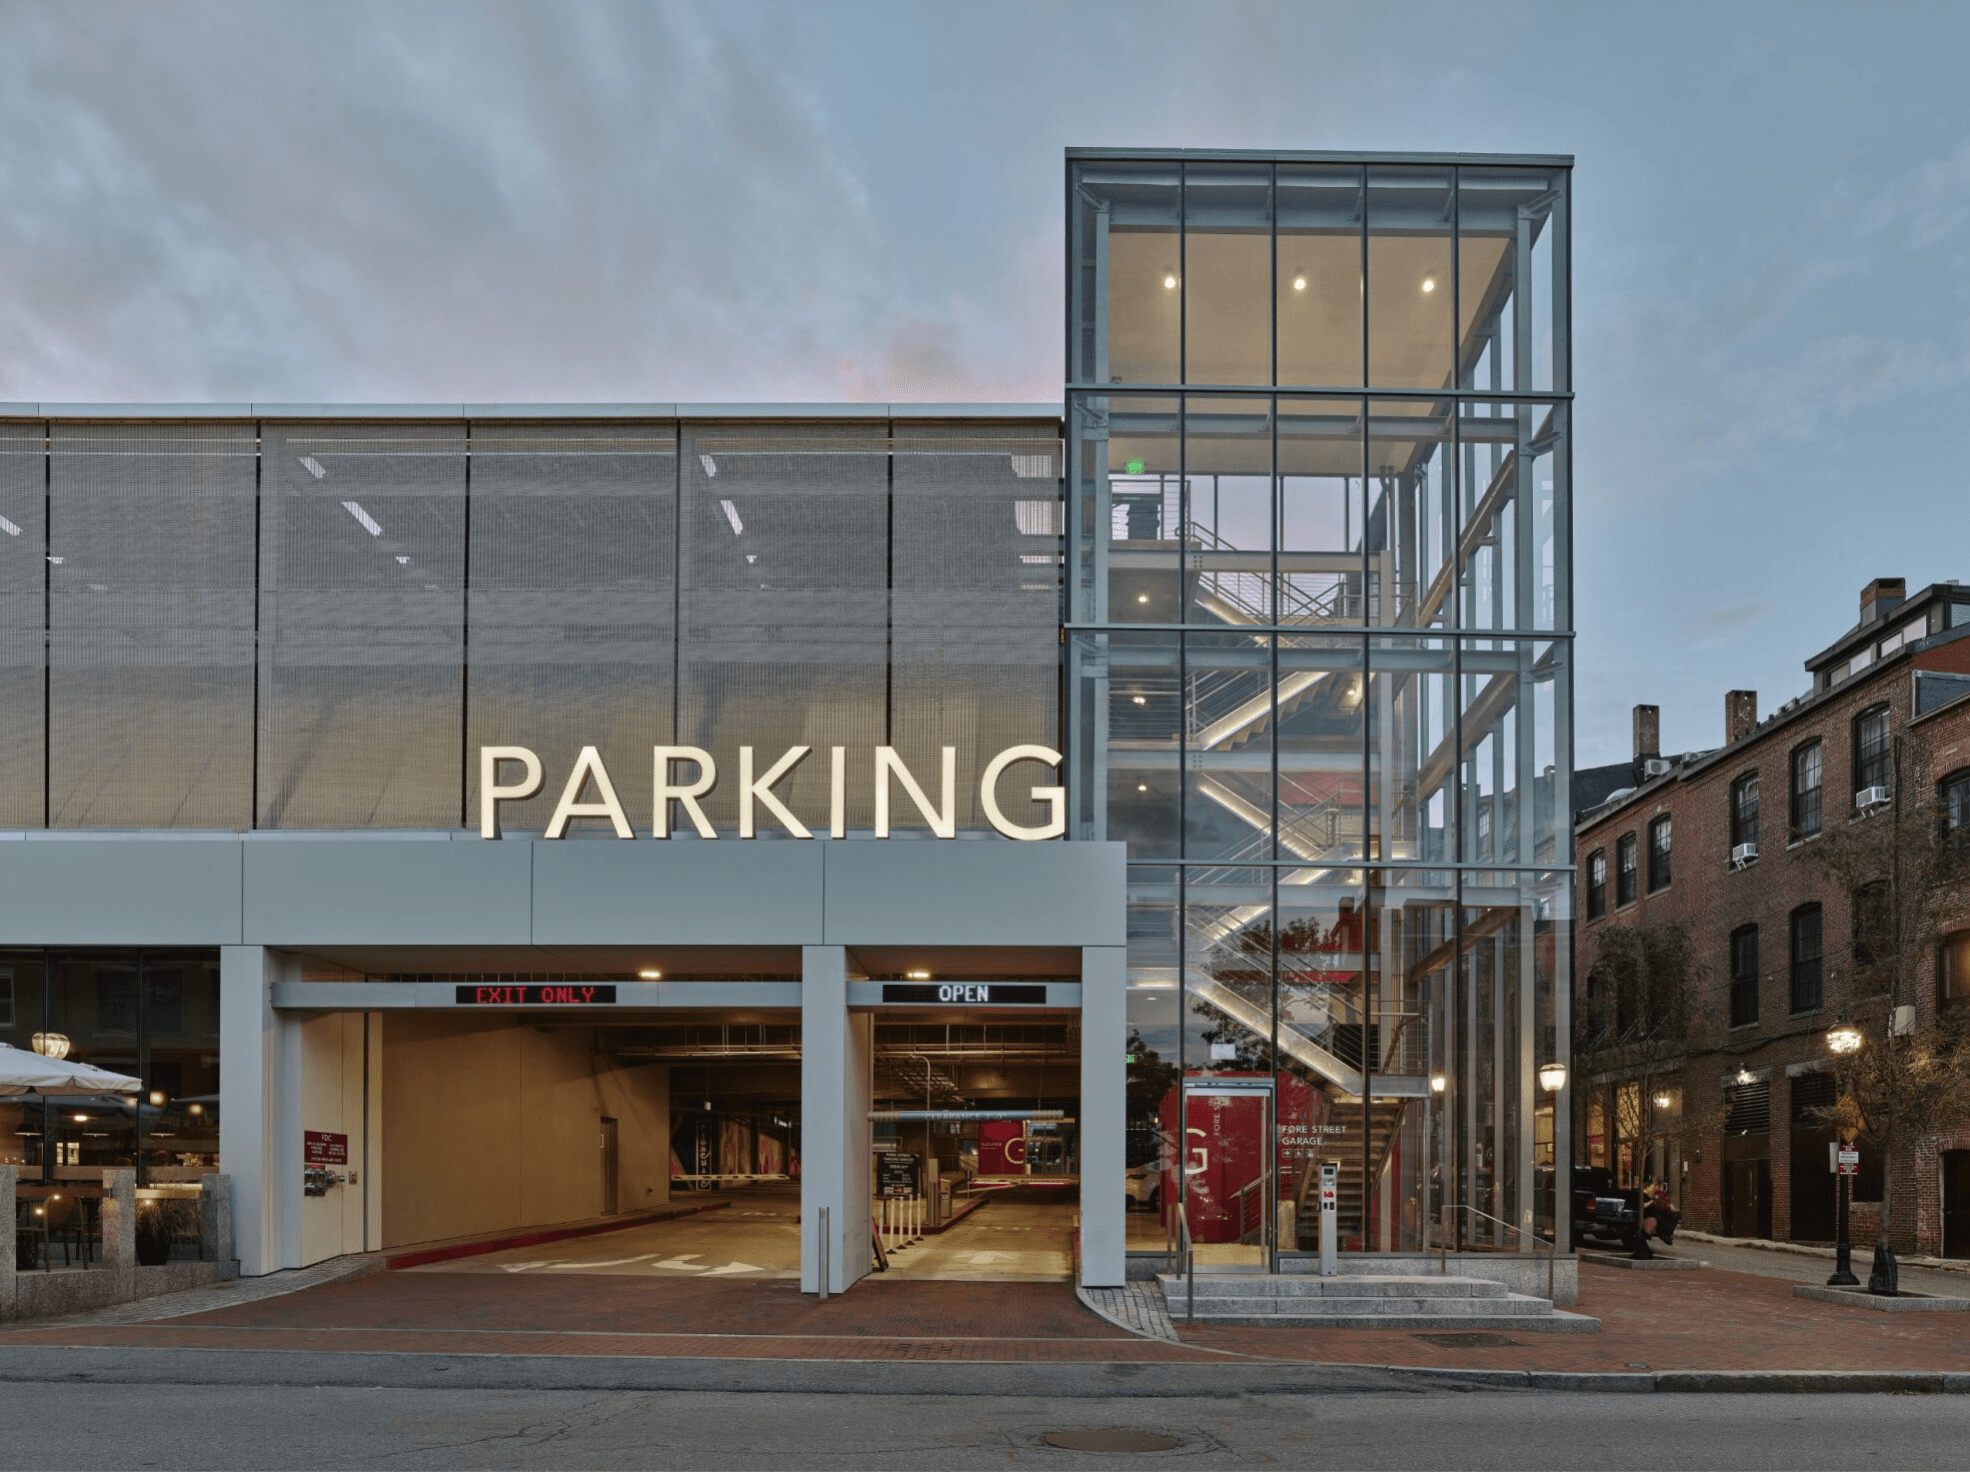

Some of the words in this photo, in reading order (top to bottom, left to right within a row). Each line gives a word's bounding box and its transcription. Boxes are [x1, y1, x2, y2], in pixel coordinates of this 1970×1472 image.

[480, 744, 1066, 841] PARKING
[476, 986, 528, 1004] EXIT
[541, 986, 595, 1004] ONLY
[938, 985, 989, 1002] OPEN
[924, 1112, 981, 1121] CLEARANCE
[1282, 1125, 1308, 1134] FORE
[1311, 1125, 1347, 1134] STREET
[1282, 1137, 1323, 1146] GARAGE
